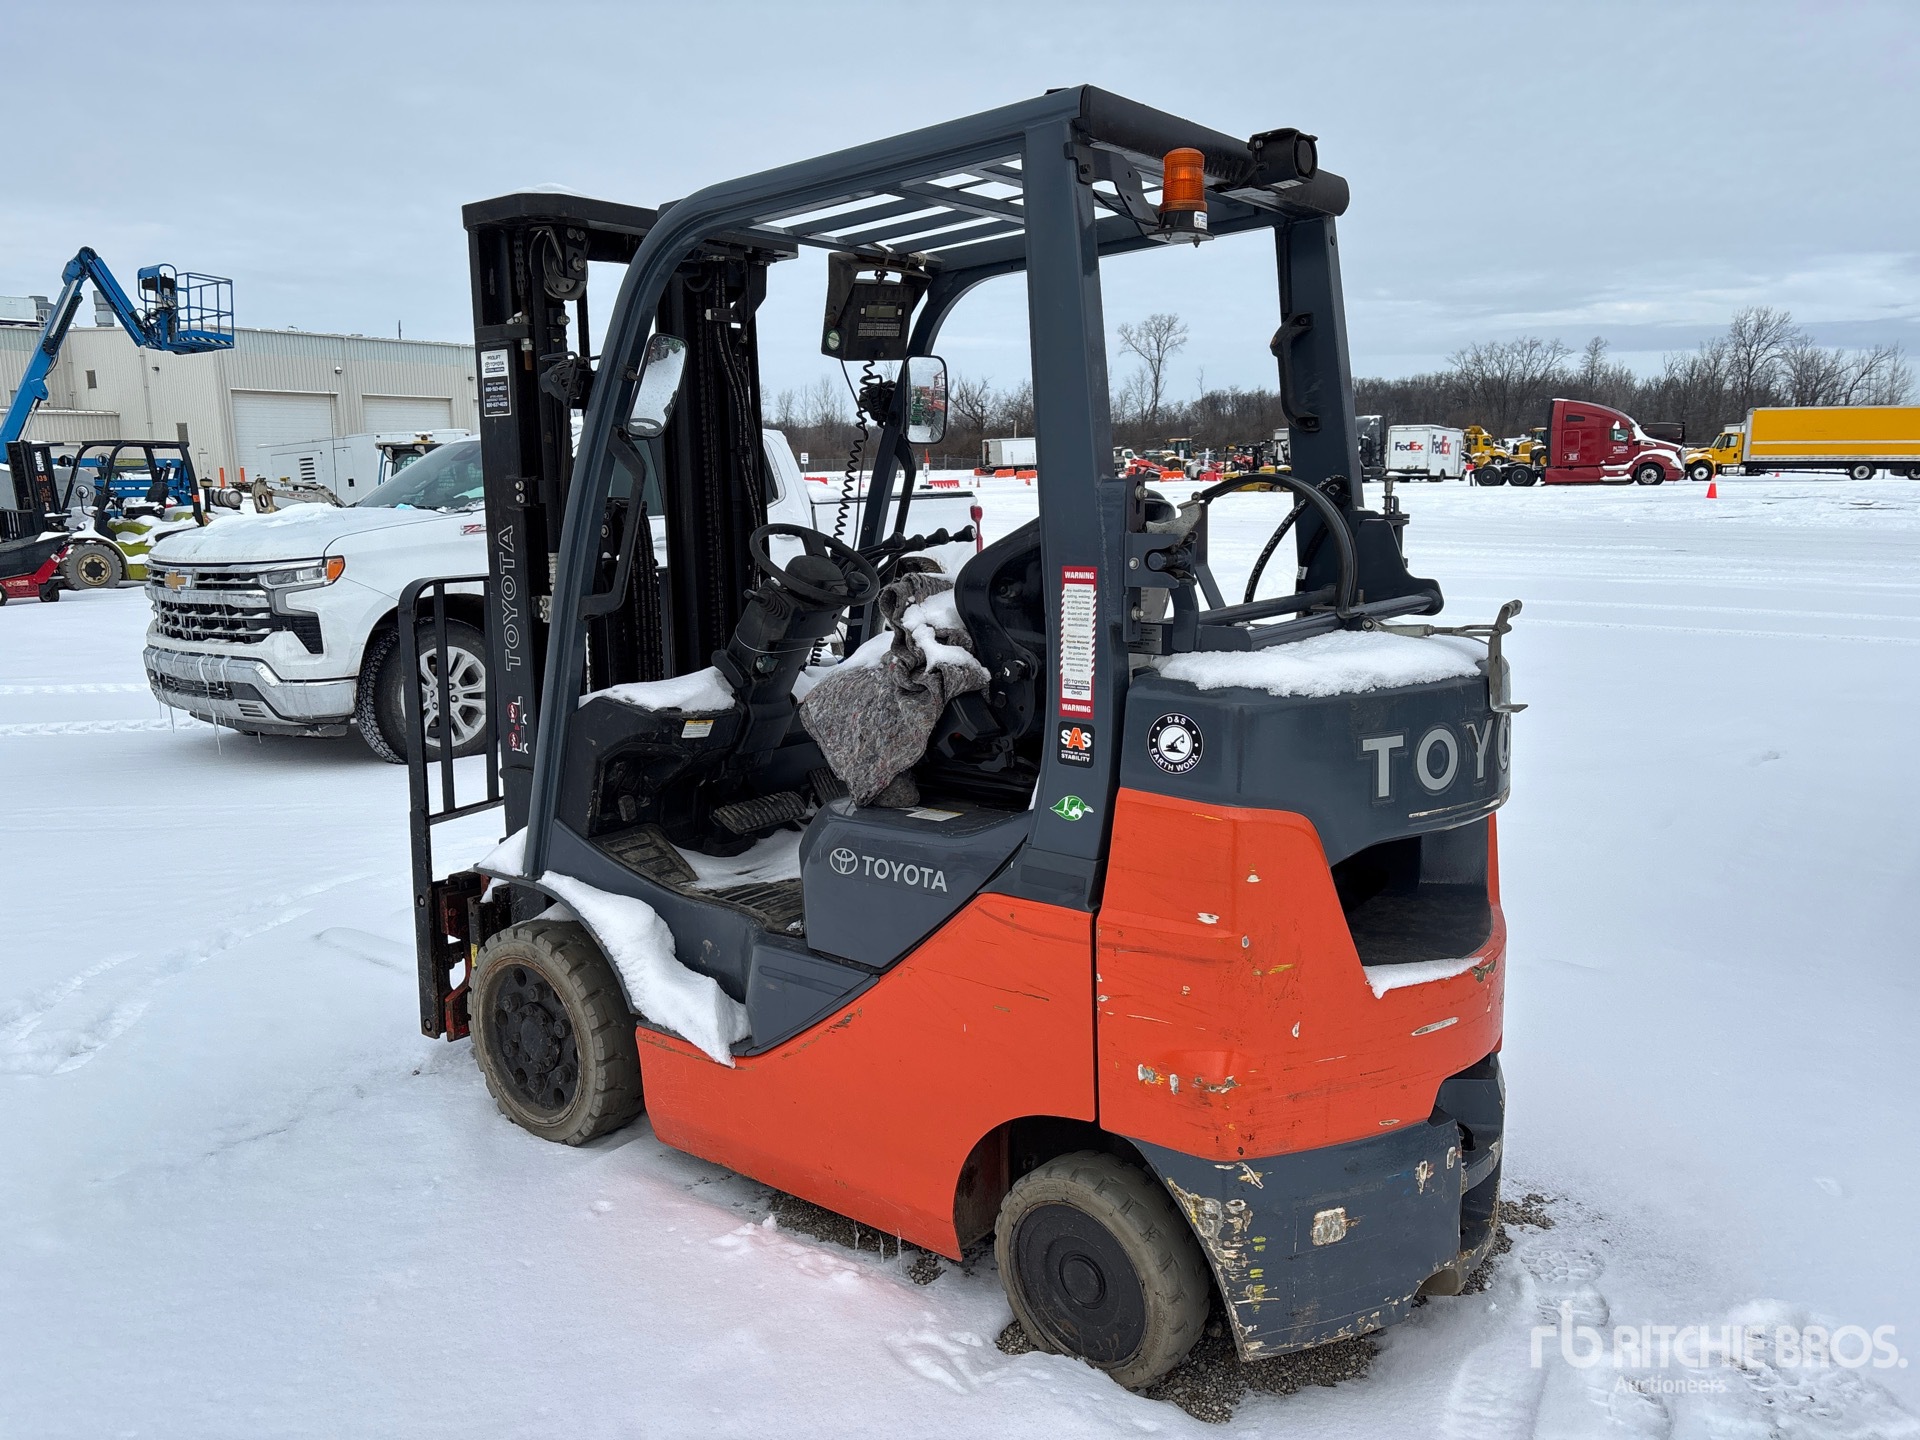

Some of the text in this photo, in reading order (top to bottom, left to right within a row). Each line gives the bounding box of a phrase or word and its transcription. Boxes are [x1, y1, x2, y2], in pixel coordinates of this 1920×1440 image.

[1394, 441, 1424, 451] FedEx
[1431, 434, 1451, 455] FedEx
[34, 451, 45, 472] CLARK
[1064, 571, 1094, 580] WARNING
[498, 524, 521, 671] TOYOTA
[1062, 703, 1091, 713] WARNING
[1166, 716, 1187, 725] D&S
[1060, 727, 1092, 750] SAS
[1061, 754, 1090, 762] STABILITY
[1150, 747, 1199, 772] EARTH WORX
[862, 855, 948, 893] TOYOTA
